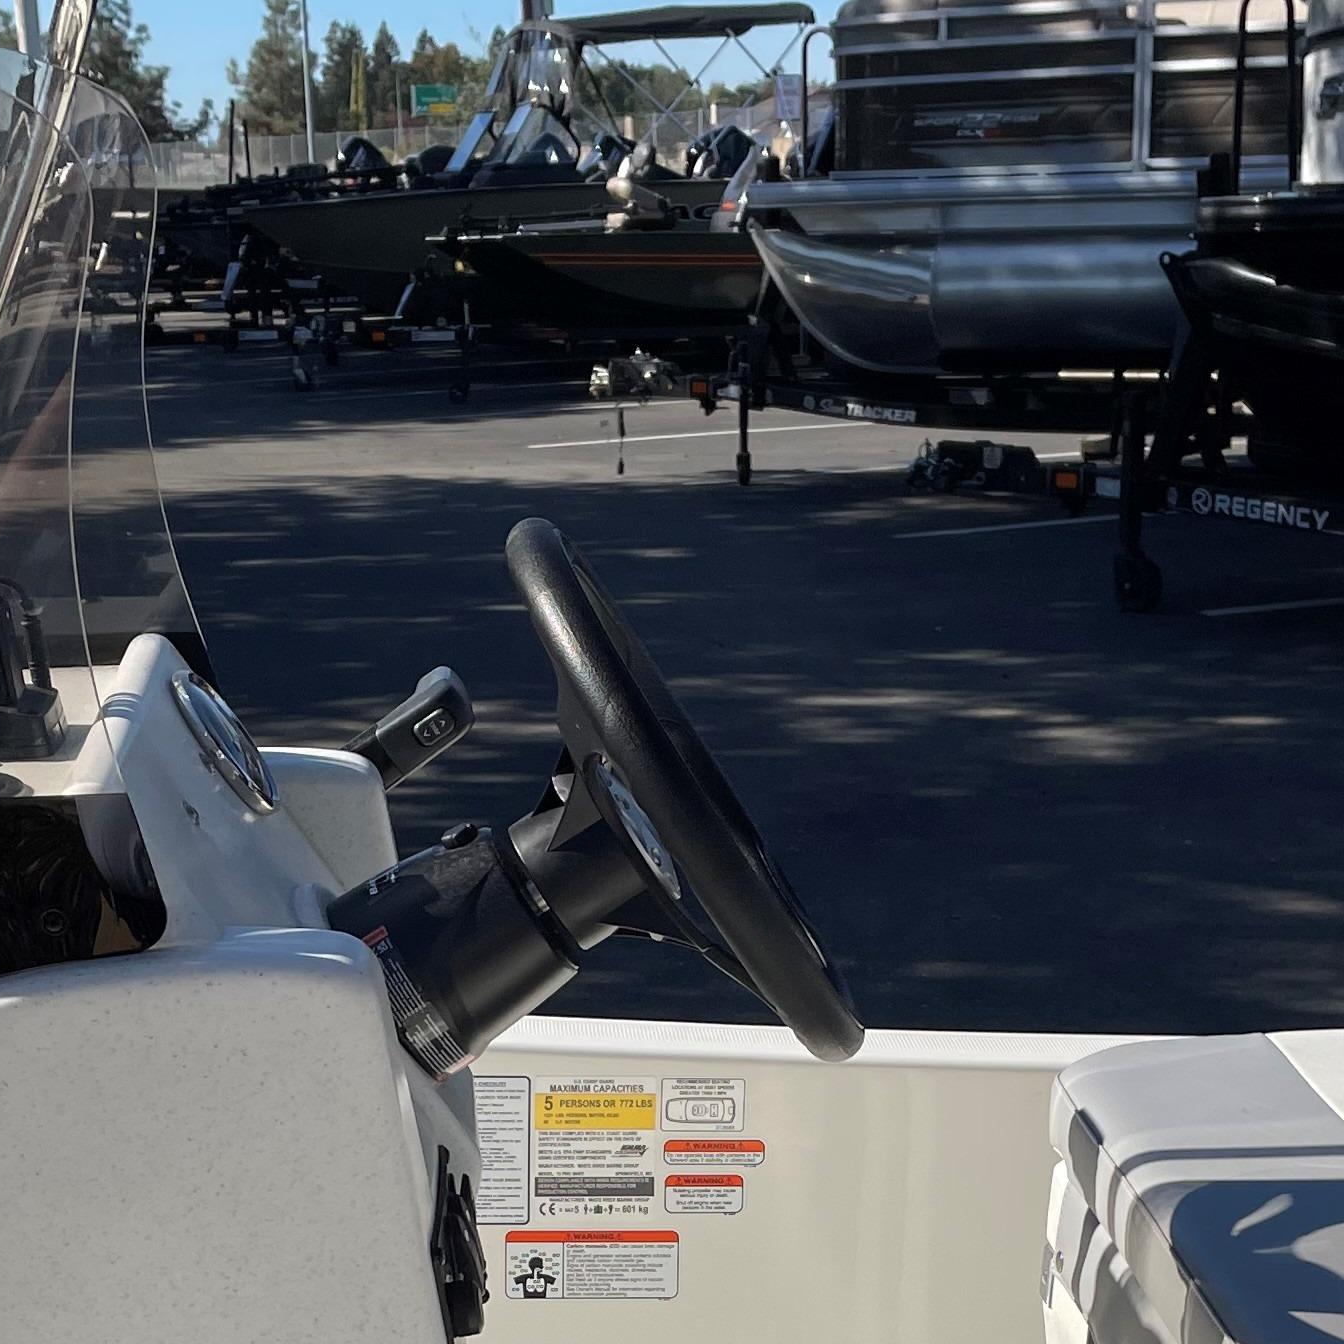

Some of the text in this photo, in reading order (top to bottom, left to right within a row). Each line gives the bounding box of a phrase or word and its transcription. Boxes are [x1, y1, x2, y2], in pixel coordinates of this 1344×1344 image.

[846, 403, 917, 423] TRACKER
[1214, 493, 1330, 531] REGENCY
[549, 1084, 644, 1093] MAXIMUM CAPACITIES
[544, 1095, 653, 1111] 5 PERSONS OR 772 LBS
[692, 1142, 736, 1150] WARNING
[683, 1176, 724, 1184] WARNING
[539, 1203, 556, 1216] CE
[622, 1205, 636, 1214] 601
[638, 1205, 649, 1216] kg
